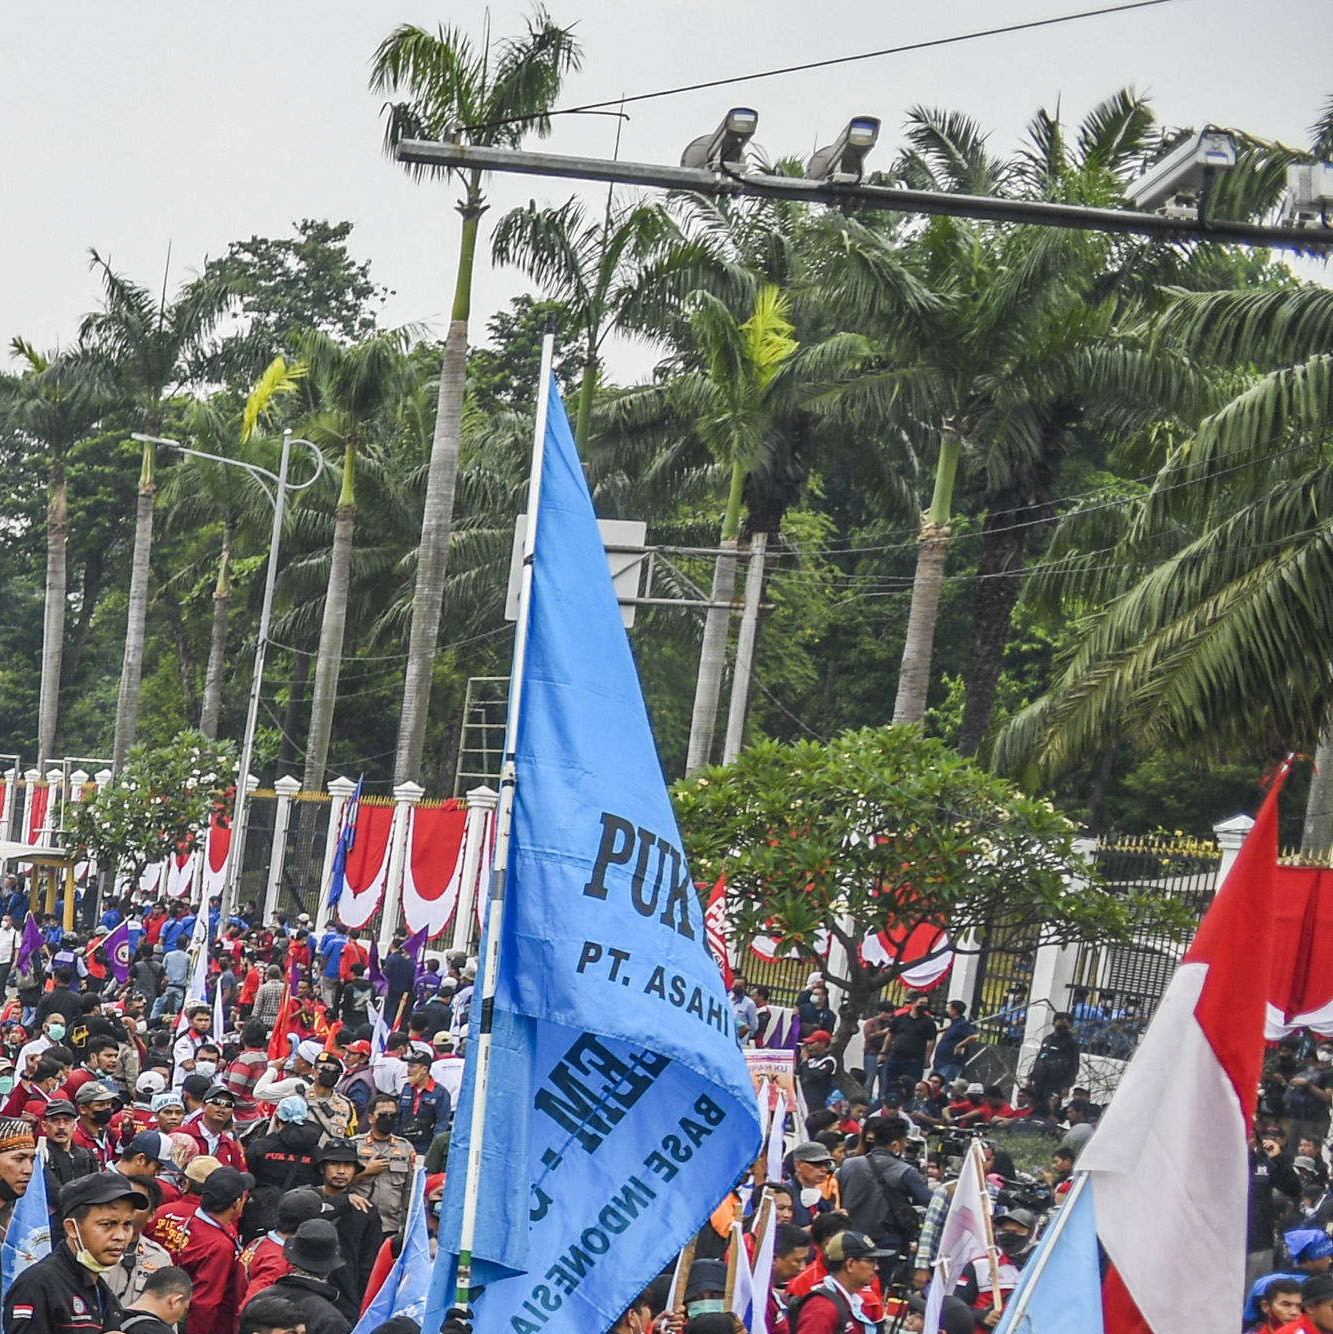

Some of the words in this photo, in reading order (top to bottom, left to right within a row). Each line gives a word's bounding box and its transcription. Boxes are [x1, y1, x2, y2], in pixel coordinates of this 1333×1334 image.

[582, 811, 695, 940] PUK
[576, 940, 631, 986] PT.
[644, 965, 730, 1038] ASAHI
